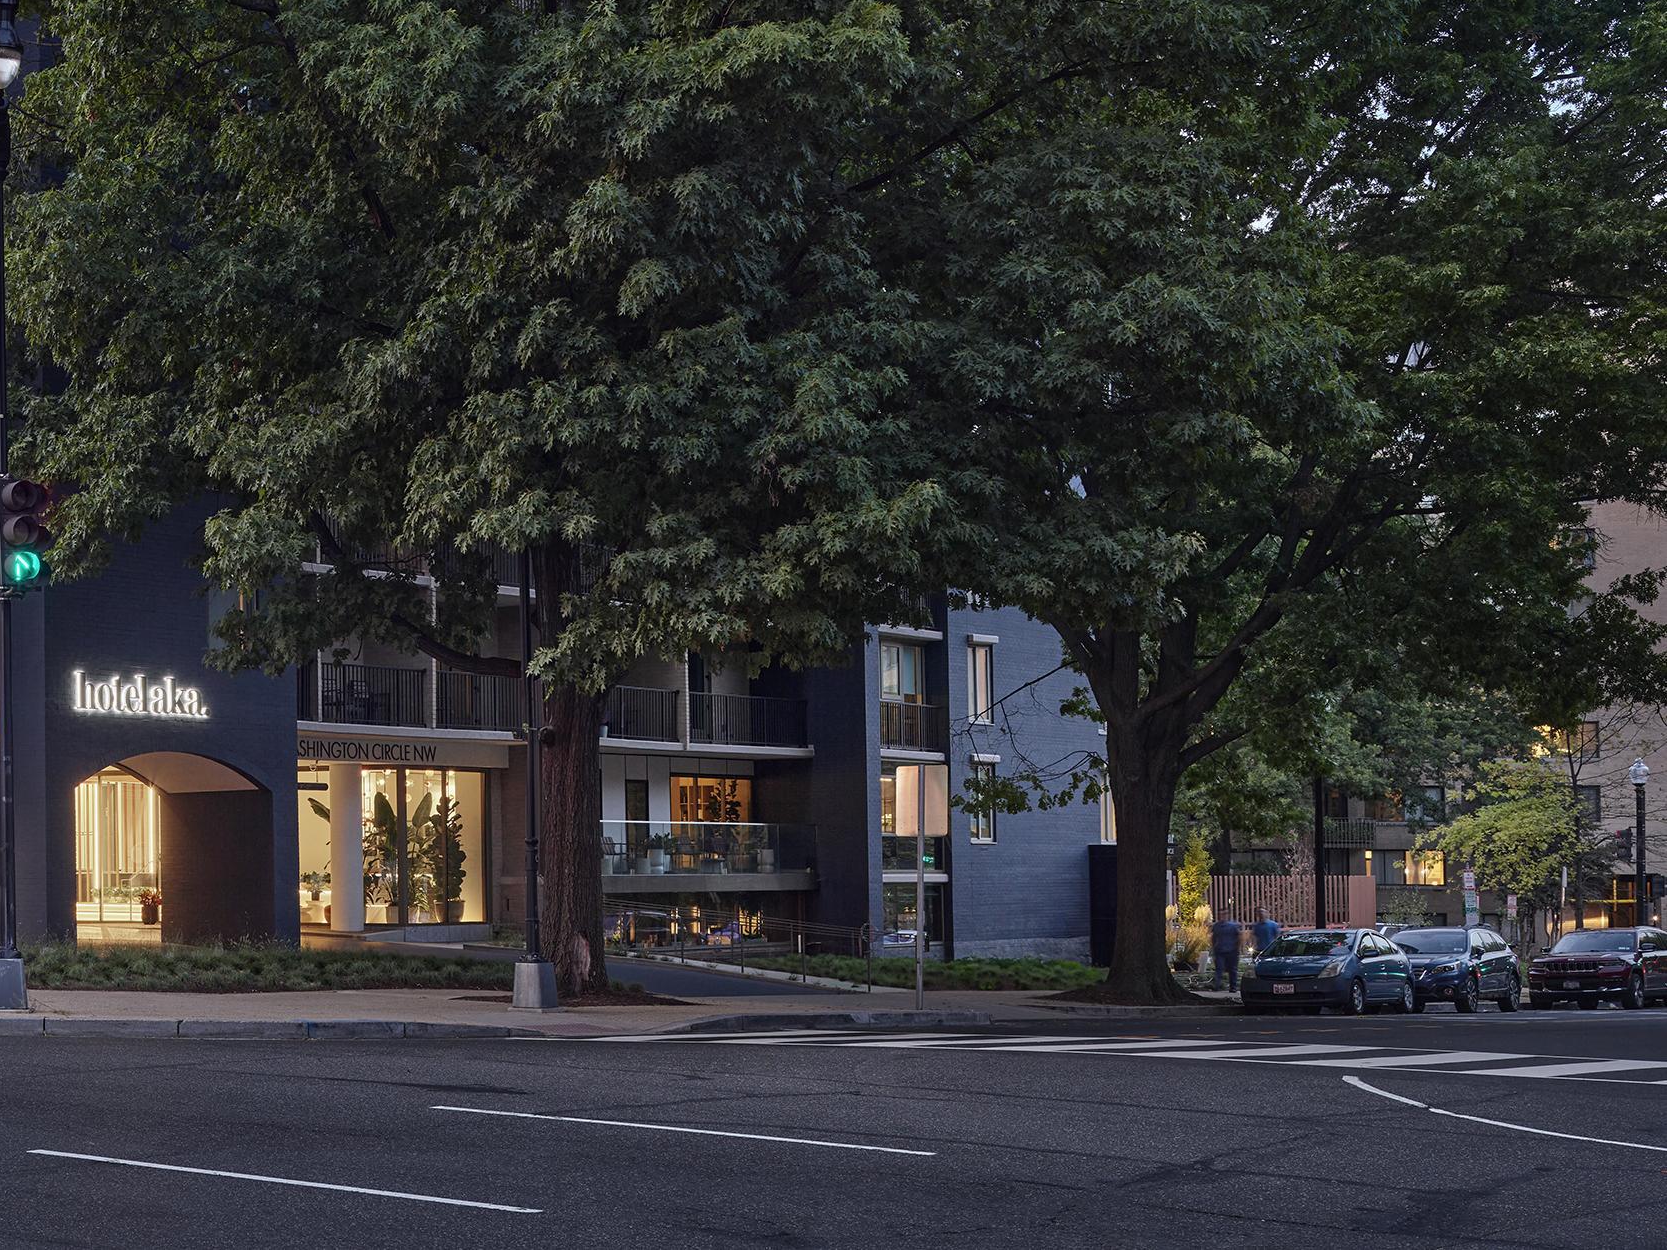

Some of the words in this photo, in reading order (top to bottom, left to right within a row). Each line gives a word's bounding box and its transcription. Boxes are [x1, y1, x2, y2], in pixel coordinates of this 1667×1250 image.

[297, 739, 369, 760] SHINGTON
[372, 743, 411, 761] CIRCLE
[413, 745, 437, 762] NW
